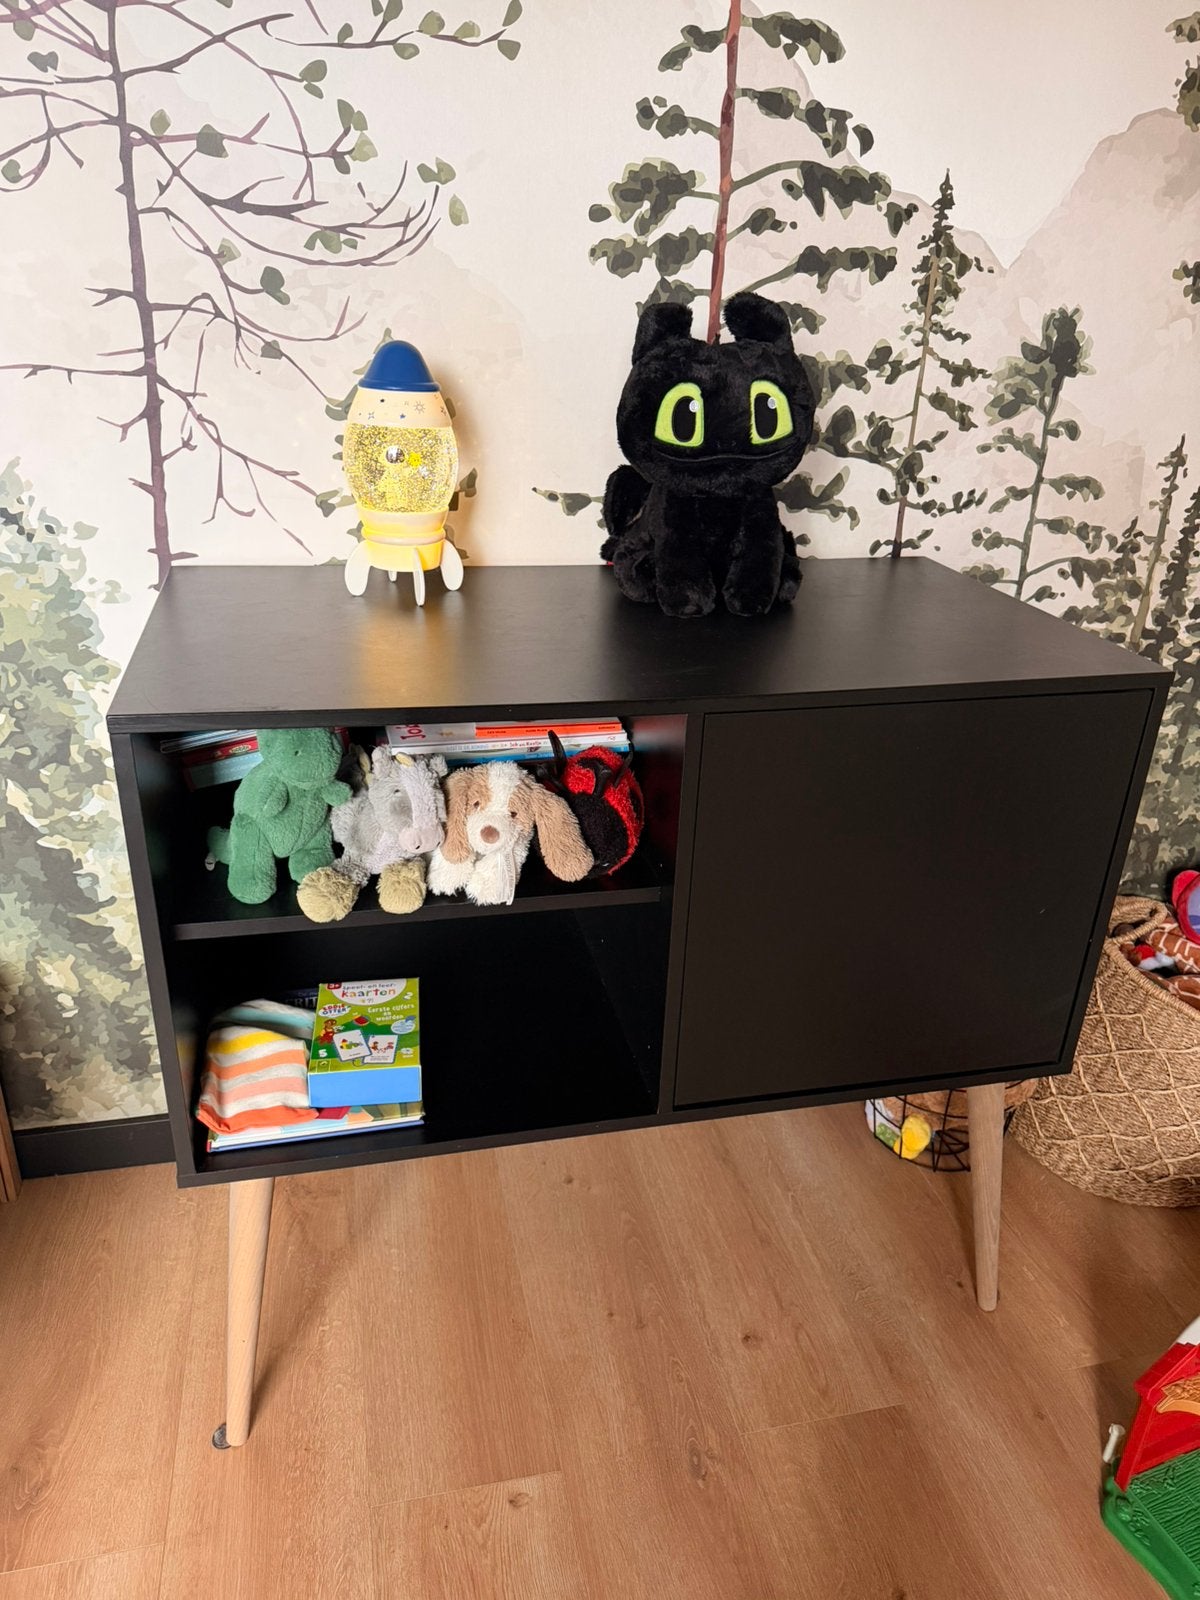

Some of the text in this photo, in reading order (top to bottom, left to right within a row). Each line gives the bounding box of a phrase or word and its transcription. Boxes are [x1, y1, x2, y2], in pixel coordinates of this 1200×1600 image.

[341, 987, 396, 998] kaarten
[403, 992, 413, 1000] 2
[319, 1049, 328, 1058] 5
